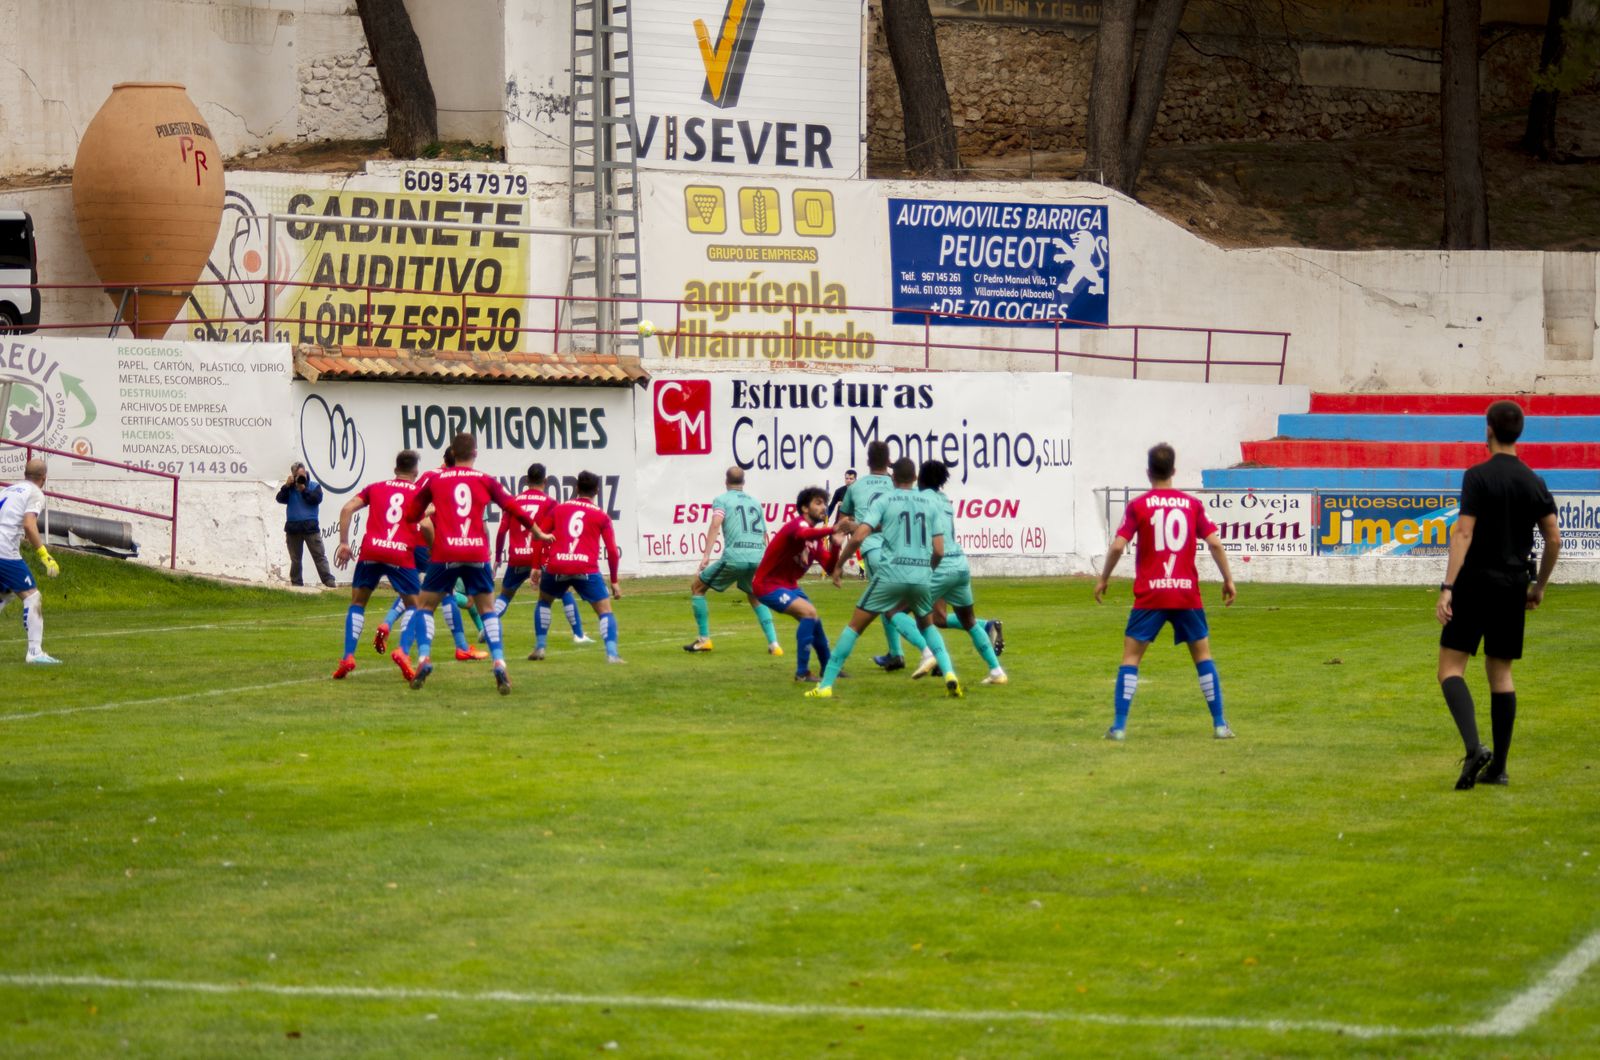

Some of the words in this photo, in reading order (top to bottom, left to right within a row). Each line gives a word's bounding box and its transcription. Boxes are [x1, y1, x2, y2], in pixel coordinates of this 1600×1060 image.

[1036, 2, 1046, 17] Y
[624, 115, 834, 168] VISEVER
[404, 170, 443, 192] 609
[448, 172, 472, 193] 54
[477, 173, 500, 195] 79
[505, 174, 528, 195] 79
[286, 193, 524, 249] GABINETE
[896, 204, 1021, 229] AUTOMOVILES
[1025, 208, 1102, 230] BARRIGA
[709, 247, 743, 260] GRUPO
[746, 248, 759, 260] DE
[761, 248, 817, 262] EMPRESAS
[939, 234, 1051, 269] PEUGEOT
[310, 252, 503, 295] AUDITIVO
[921, 272, 935, 282] 967
[936, 273, 948, 282] 145
[949, 273, 961, 282] 261
[983, 274, 1003, 284] Pedro
[1005, 275, 1031, 286] Manuel
[1049, 276, 1057, 286] 12
[684, 270, 847, 322] agrícola
[901, 285, 922, 295] Móvil.
[923, 286, 933, 295] 611
[934, 286, 948, 295] 030
[949, 286, 962, 296] 958
[975, 287, 1019, 298] Villarrobledo
[1020, 289, 1055, 300] (Albacete)
[970, 300, 990, 318] 70
[995, 301, 1069, 323] COCHES
[298, 294, 397, 349] LÓPEZ
[401, 305, 521, 352] ESPEJO
[656, 319, 875, 360] villarrobledo
[118, 347, 183, 357] RECOGEMOS:
[118, 360, 149, 371] PAPEL,
[153, 361, 195, 373] CARTÓN,
[200, 362, 246, 374] PLÁSTICO,
[250, 363, 287, 374] VIDRIO,
[119, 374, 163, 386] METALES,
[119, 388, 187, 400] DESTRUIMOS:
[731, 378, 934, 411] Estructuras
[120, 402, 168, 413] ARCHIVOS
[170, 403, 182, 412] DE
[184, 403, 228, 413] EMPRESA
[121, 416, 189, 427] CERTIFICAMOS
[190, 418, 203, 427] SU
[205, 416, 272, 428] DESTRUCCIÓN
[401, 405, 608, 450] HORMIGONES
[121, 430, 174, 441] HACEMOS:
[122, 444, 180, 455] MUDANZAS,
[732, 416, 834, 470] Calero
[850, 415, 1042, 484] Montejano,
[1043, 439, 1073, 467] S.L.U.
[1, 464, 24, 474] Socie
[123, 460, 154, 473] Telf:
[158, 461, 184, 474] 967
[188, 461, 206, 474] 14
[210, 461, 229, 474] 43
[231, 462, 248, 474] 06
[386, 493, 404, 524] 8
[454, 482, 472, 517] 9
[956, 499, 1020, 519] IGON
[1146, 495, 1189, 508] IÑAQUI
[1209, 494, 1232, 508] de
[1241, 494, 1300, 513] Oveja
[1324, 495, 1458, 509] autoescuela
[568, 510, 586, 538] 6
[736, 505, 763, 534] 12
[1217, 513, 1305, 540] mán
[898, 511, 926, 548] 11
[1150, 508, 1188, 552] 10
[372, 538, 408, 551] VISEVER
[644, 534, 675, 556] Telf.
[956, 528, 1013, 550] arrobledo
[1021, 527, 1047, 554] (AB)
[1246, 544, 1258, 552] Tel.
[1261, 544, 1276, 552] 967
[1277, 544, 1285, 552] 14
[1287, 544, 1296, 552] 51
[1299, 544, 1307, 552] 10
[1581, 539, 1600, 550] 908
[556, 552, 589, 562] VISEVER
[1149, 579, 1192, 589] VISEVER
